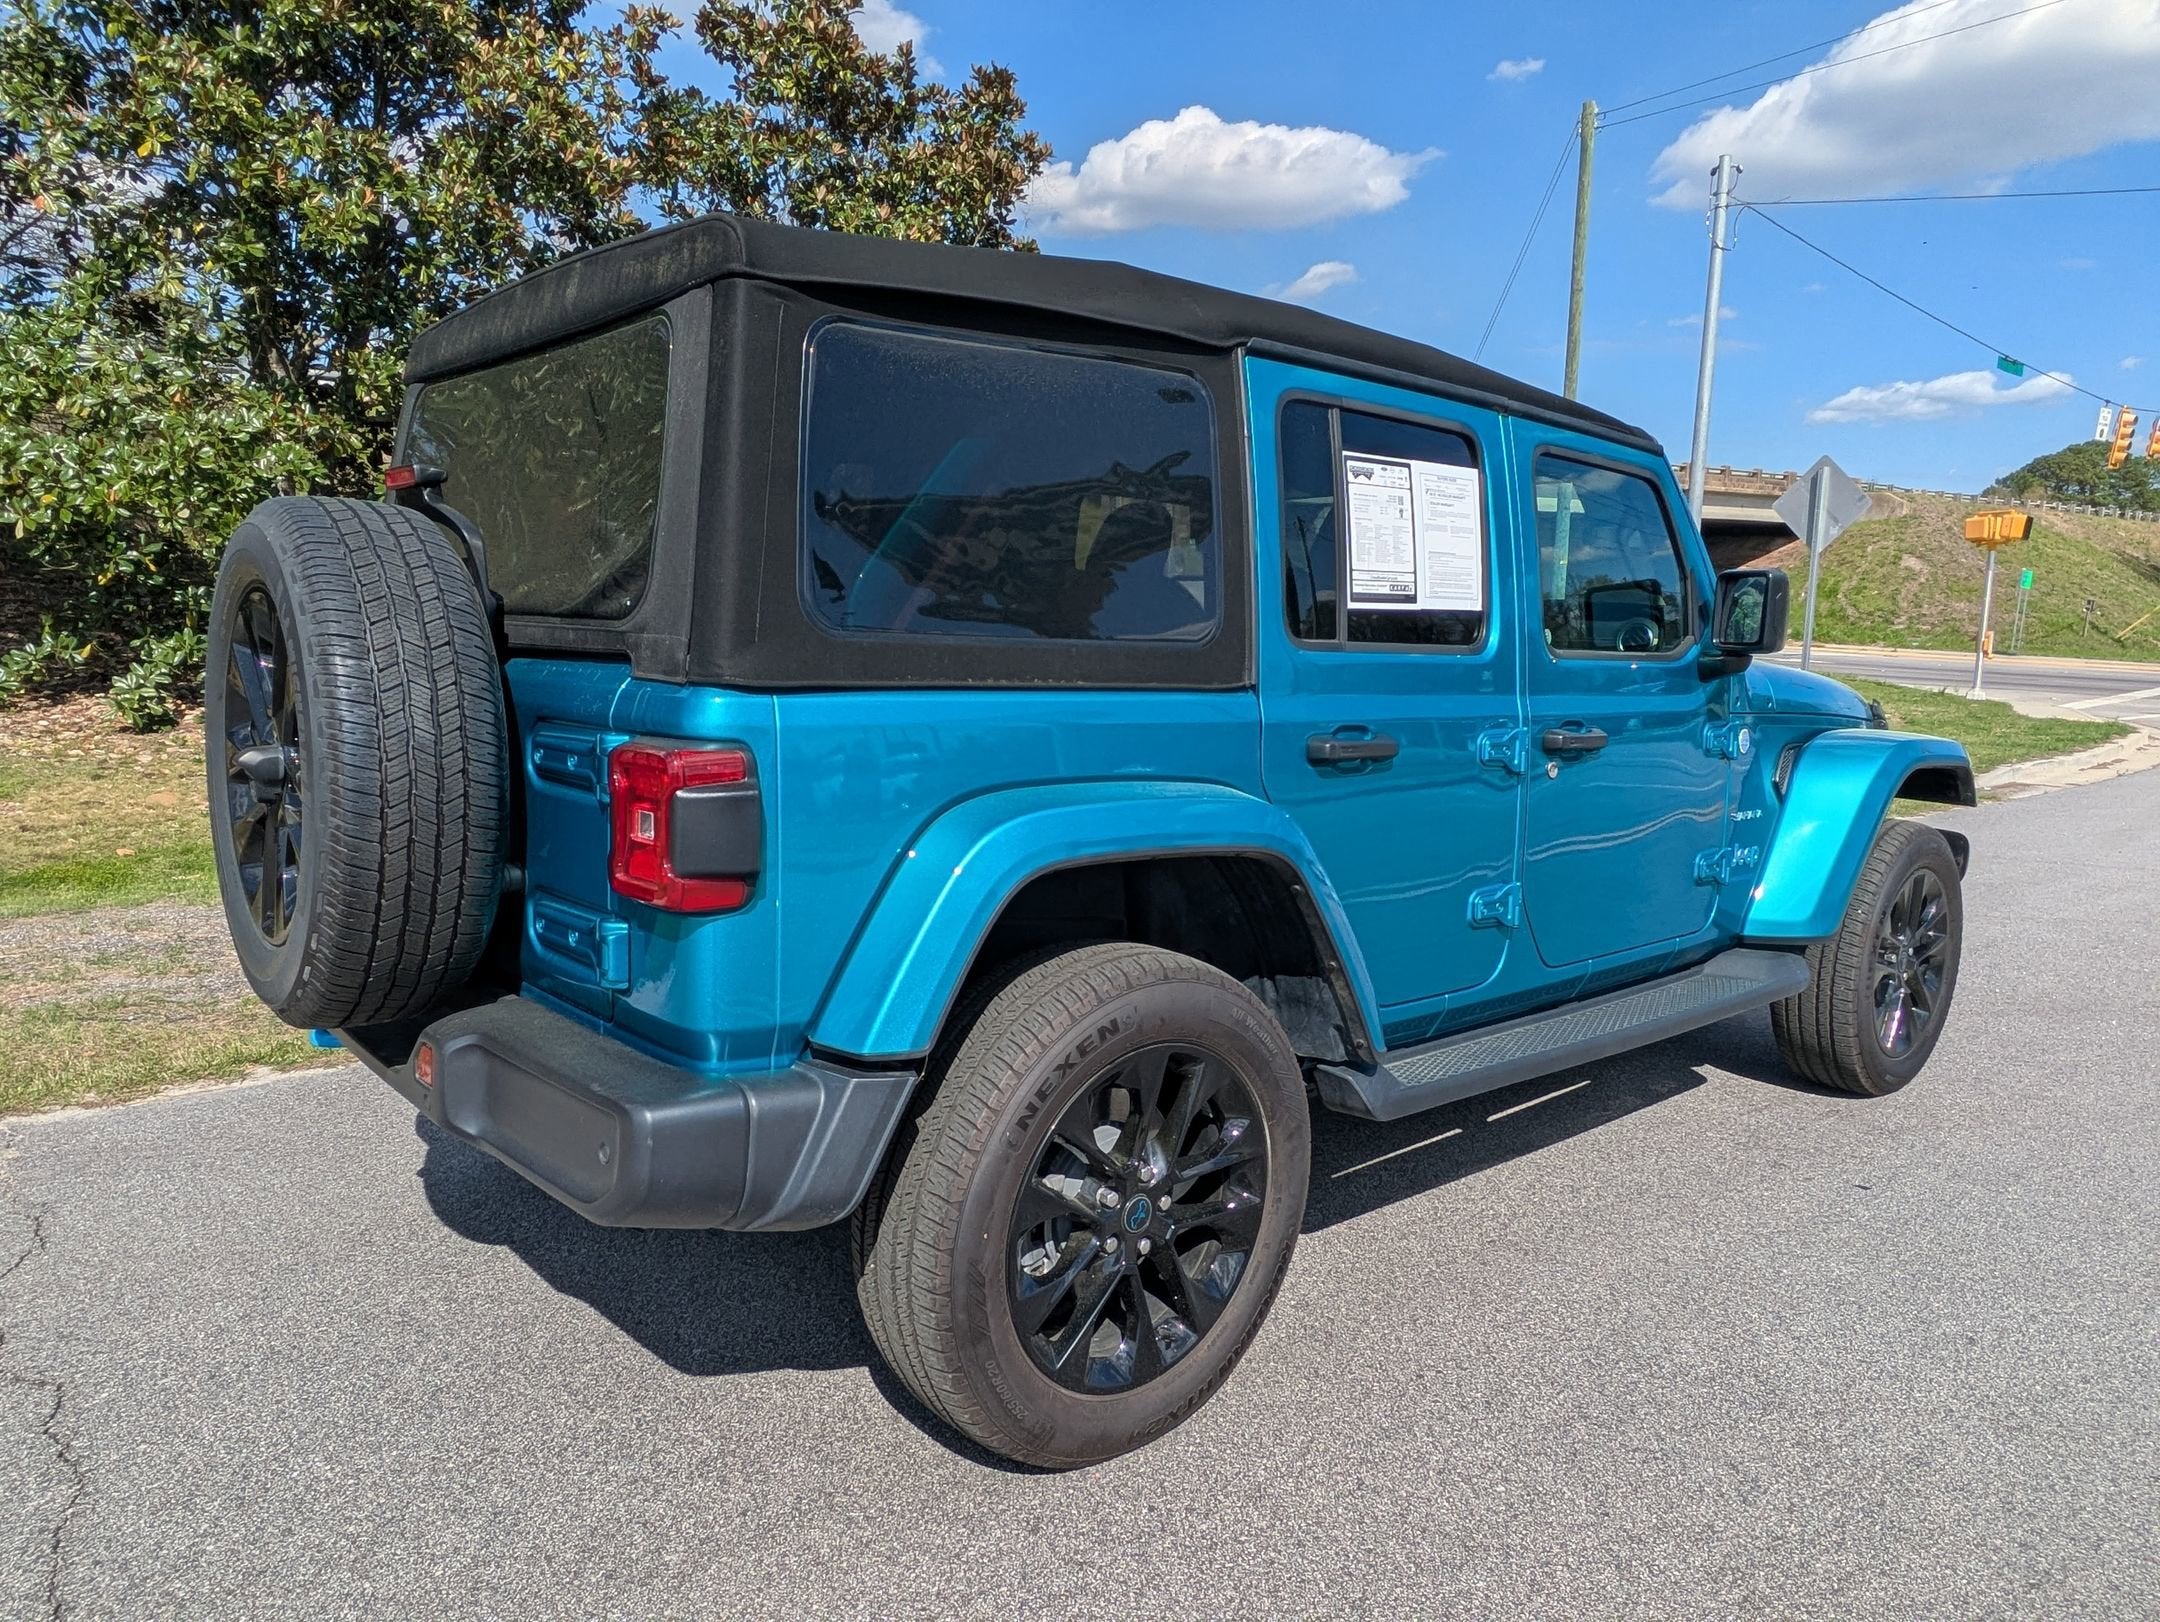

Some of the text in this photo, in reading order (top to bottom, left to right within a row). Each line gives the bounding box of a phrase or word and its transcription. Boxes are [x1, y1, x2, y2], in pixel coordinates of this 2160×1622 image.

[1730, 843, 1760, 868] Jeep
[1245, 1015, 1278, 1055] Weather
[1015, 1017, 1121, 1132] NEXEN
